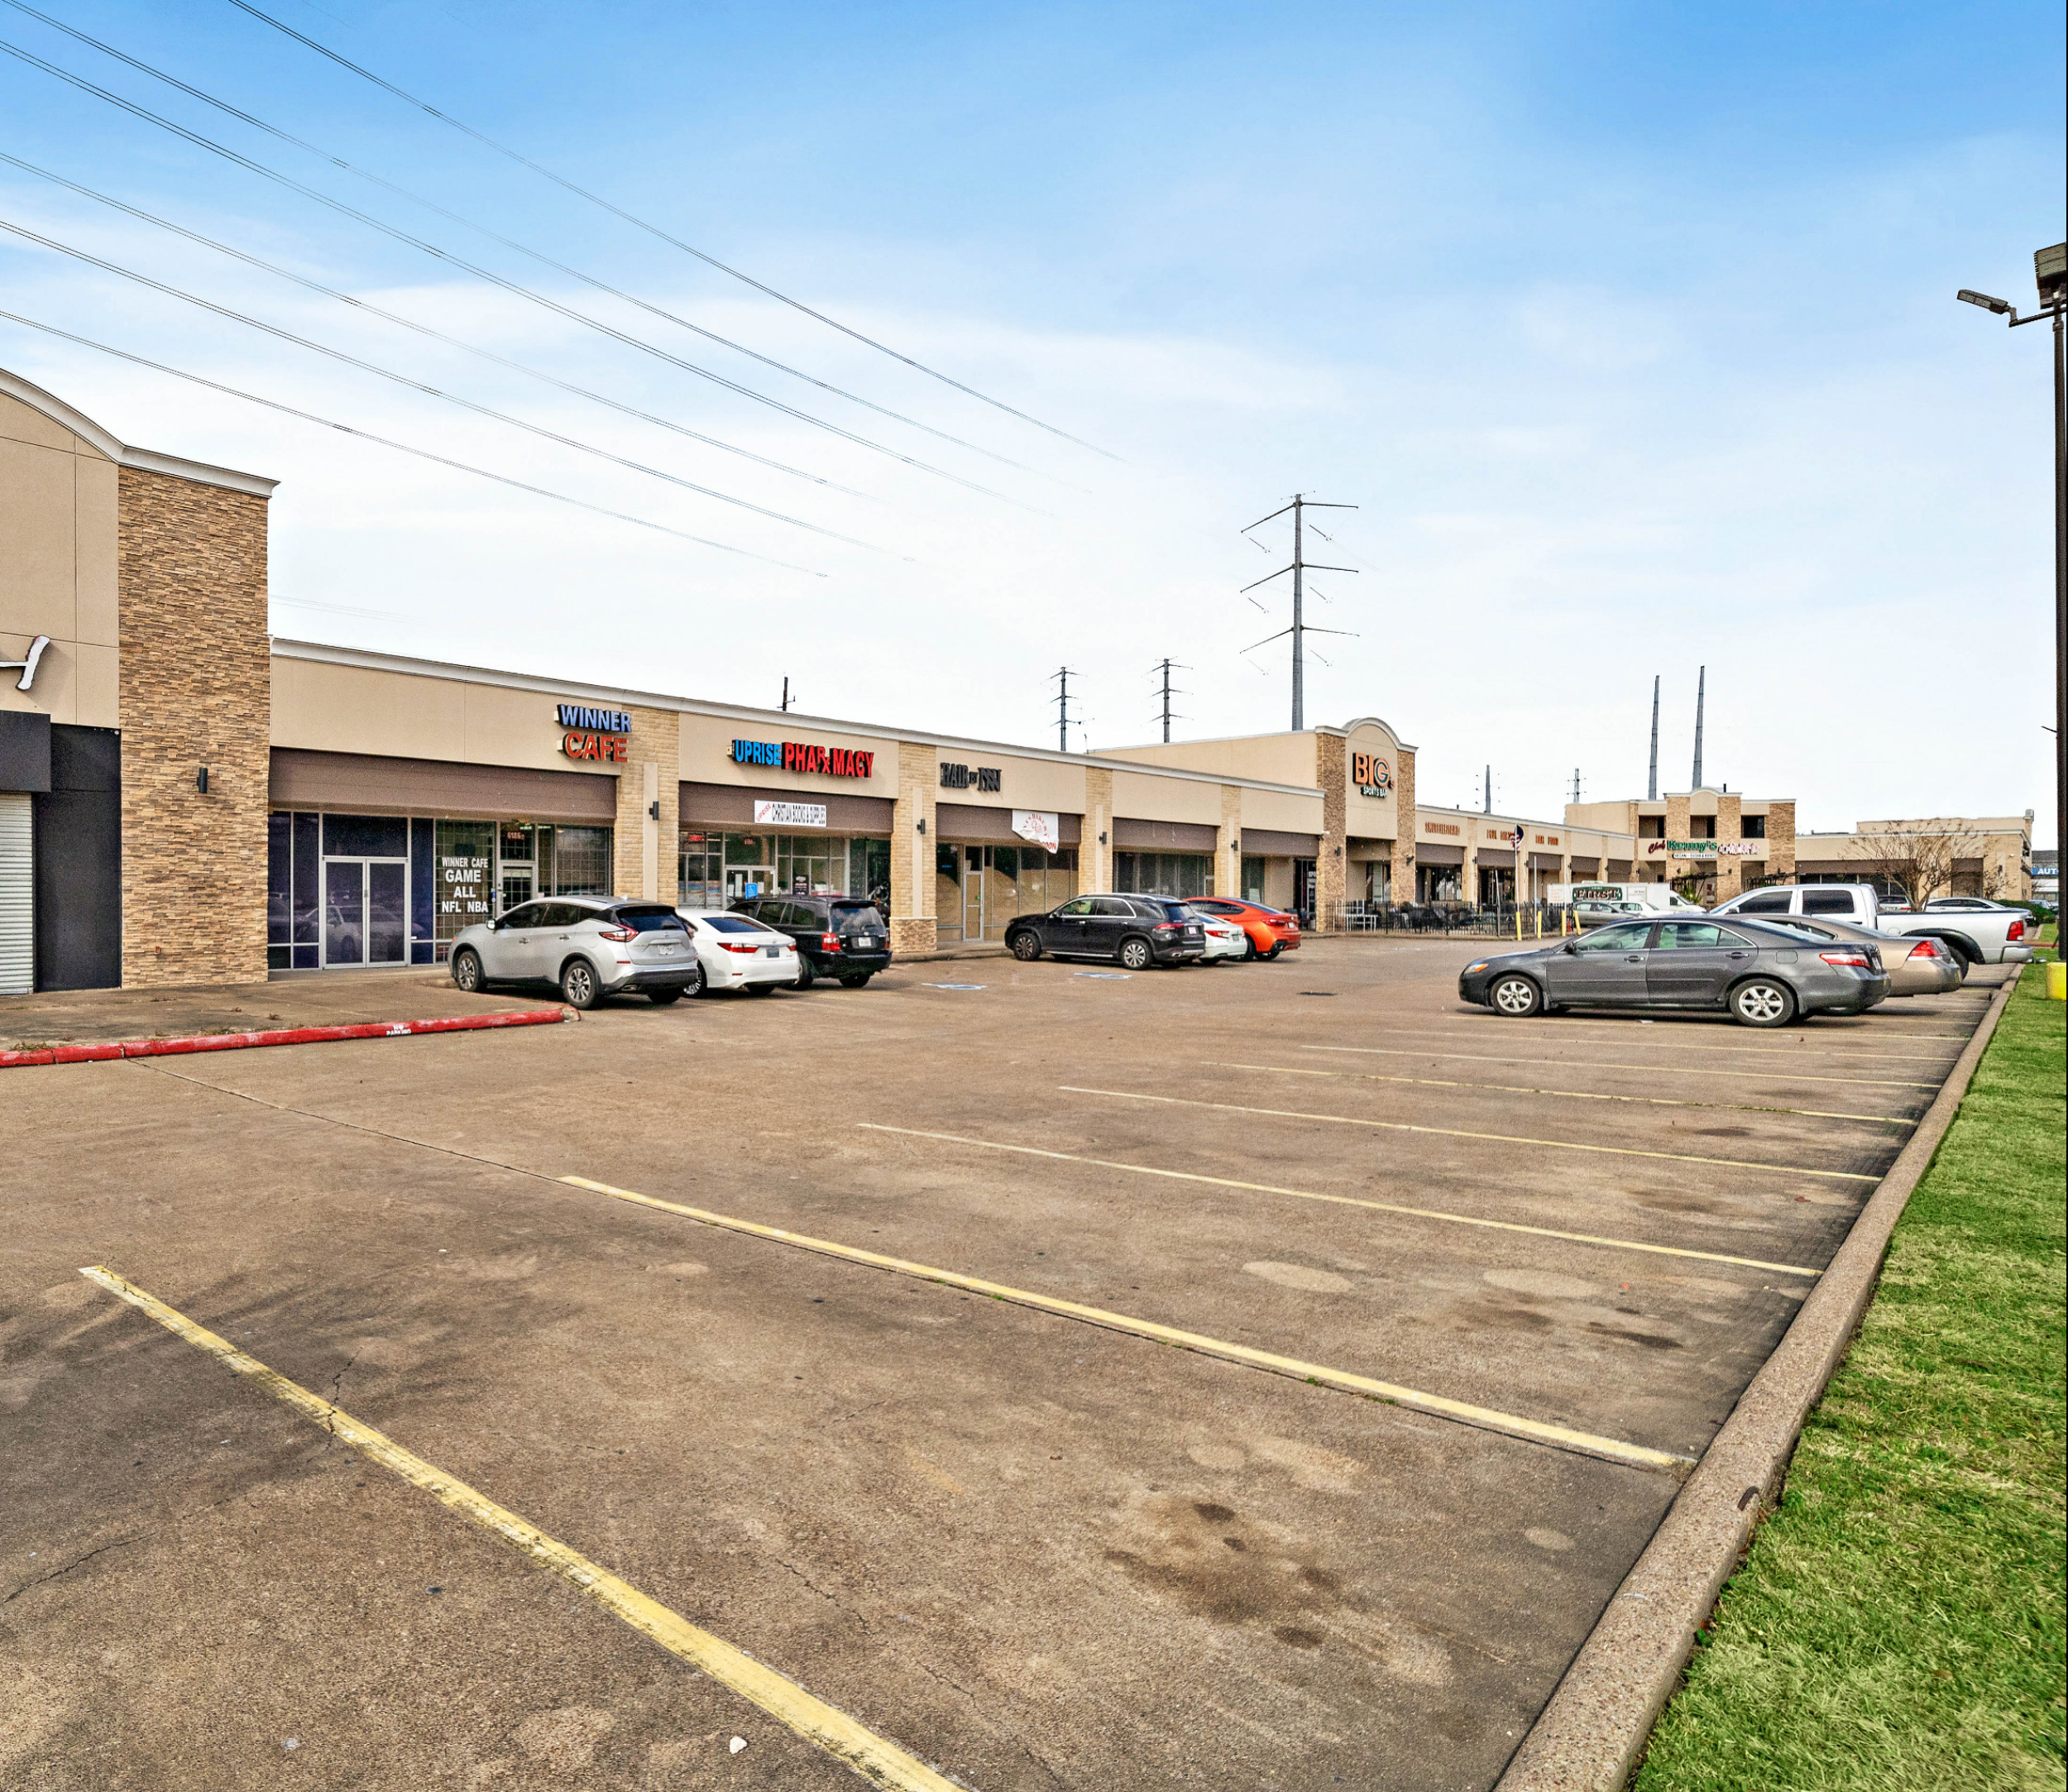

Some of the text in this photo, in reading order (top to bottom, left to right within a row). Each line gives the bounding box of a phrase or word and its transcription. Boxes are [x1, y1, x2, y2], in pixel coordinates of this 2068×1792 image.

[558, 704, 632, 732] WINNER
[562, 732, 628, 762] CAFE
[732, 739, 782, 765] UPRISE
[941, 762, 969, 788] HAIR
[755, 803, 773, 822] UPRISE
[1667, 841, 1717, 852] Kenny's
[442, 857, 488, 868] WINNER CAFE
[445, 870, 481, 883] GAME
[453, 886, 476, 898] ALL
[1576, 889, 1620, 900] FIRST
[442, 901, 489, 913] NFL NBA
